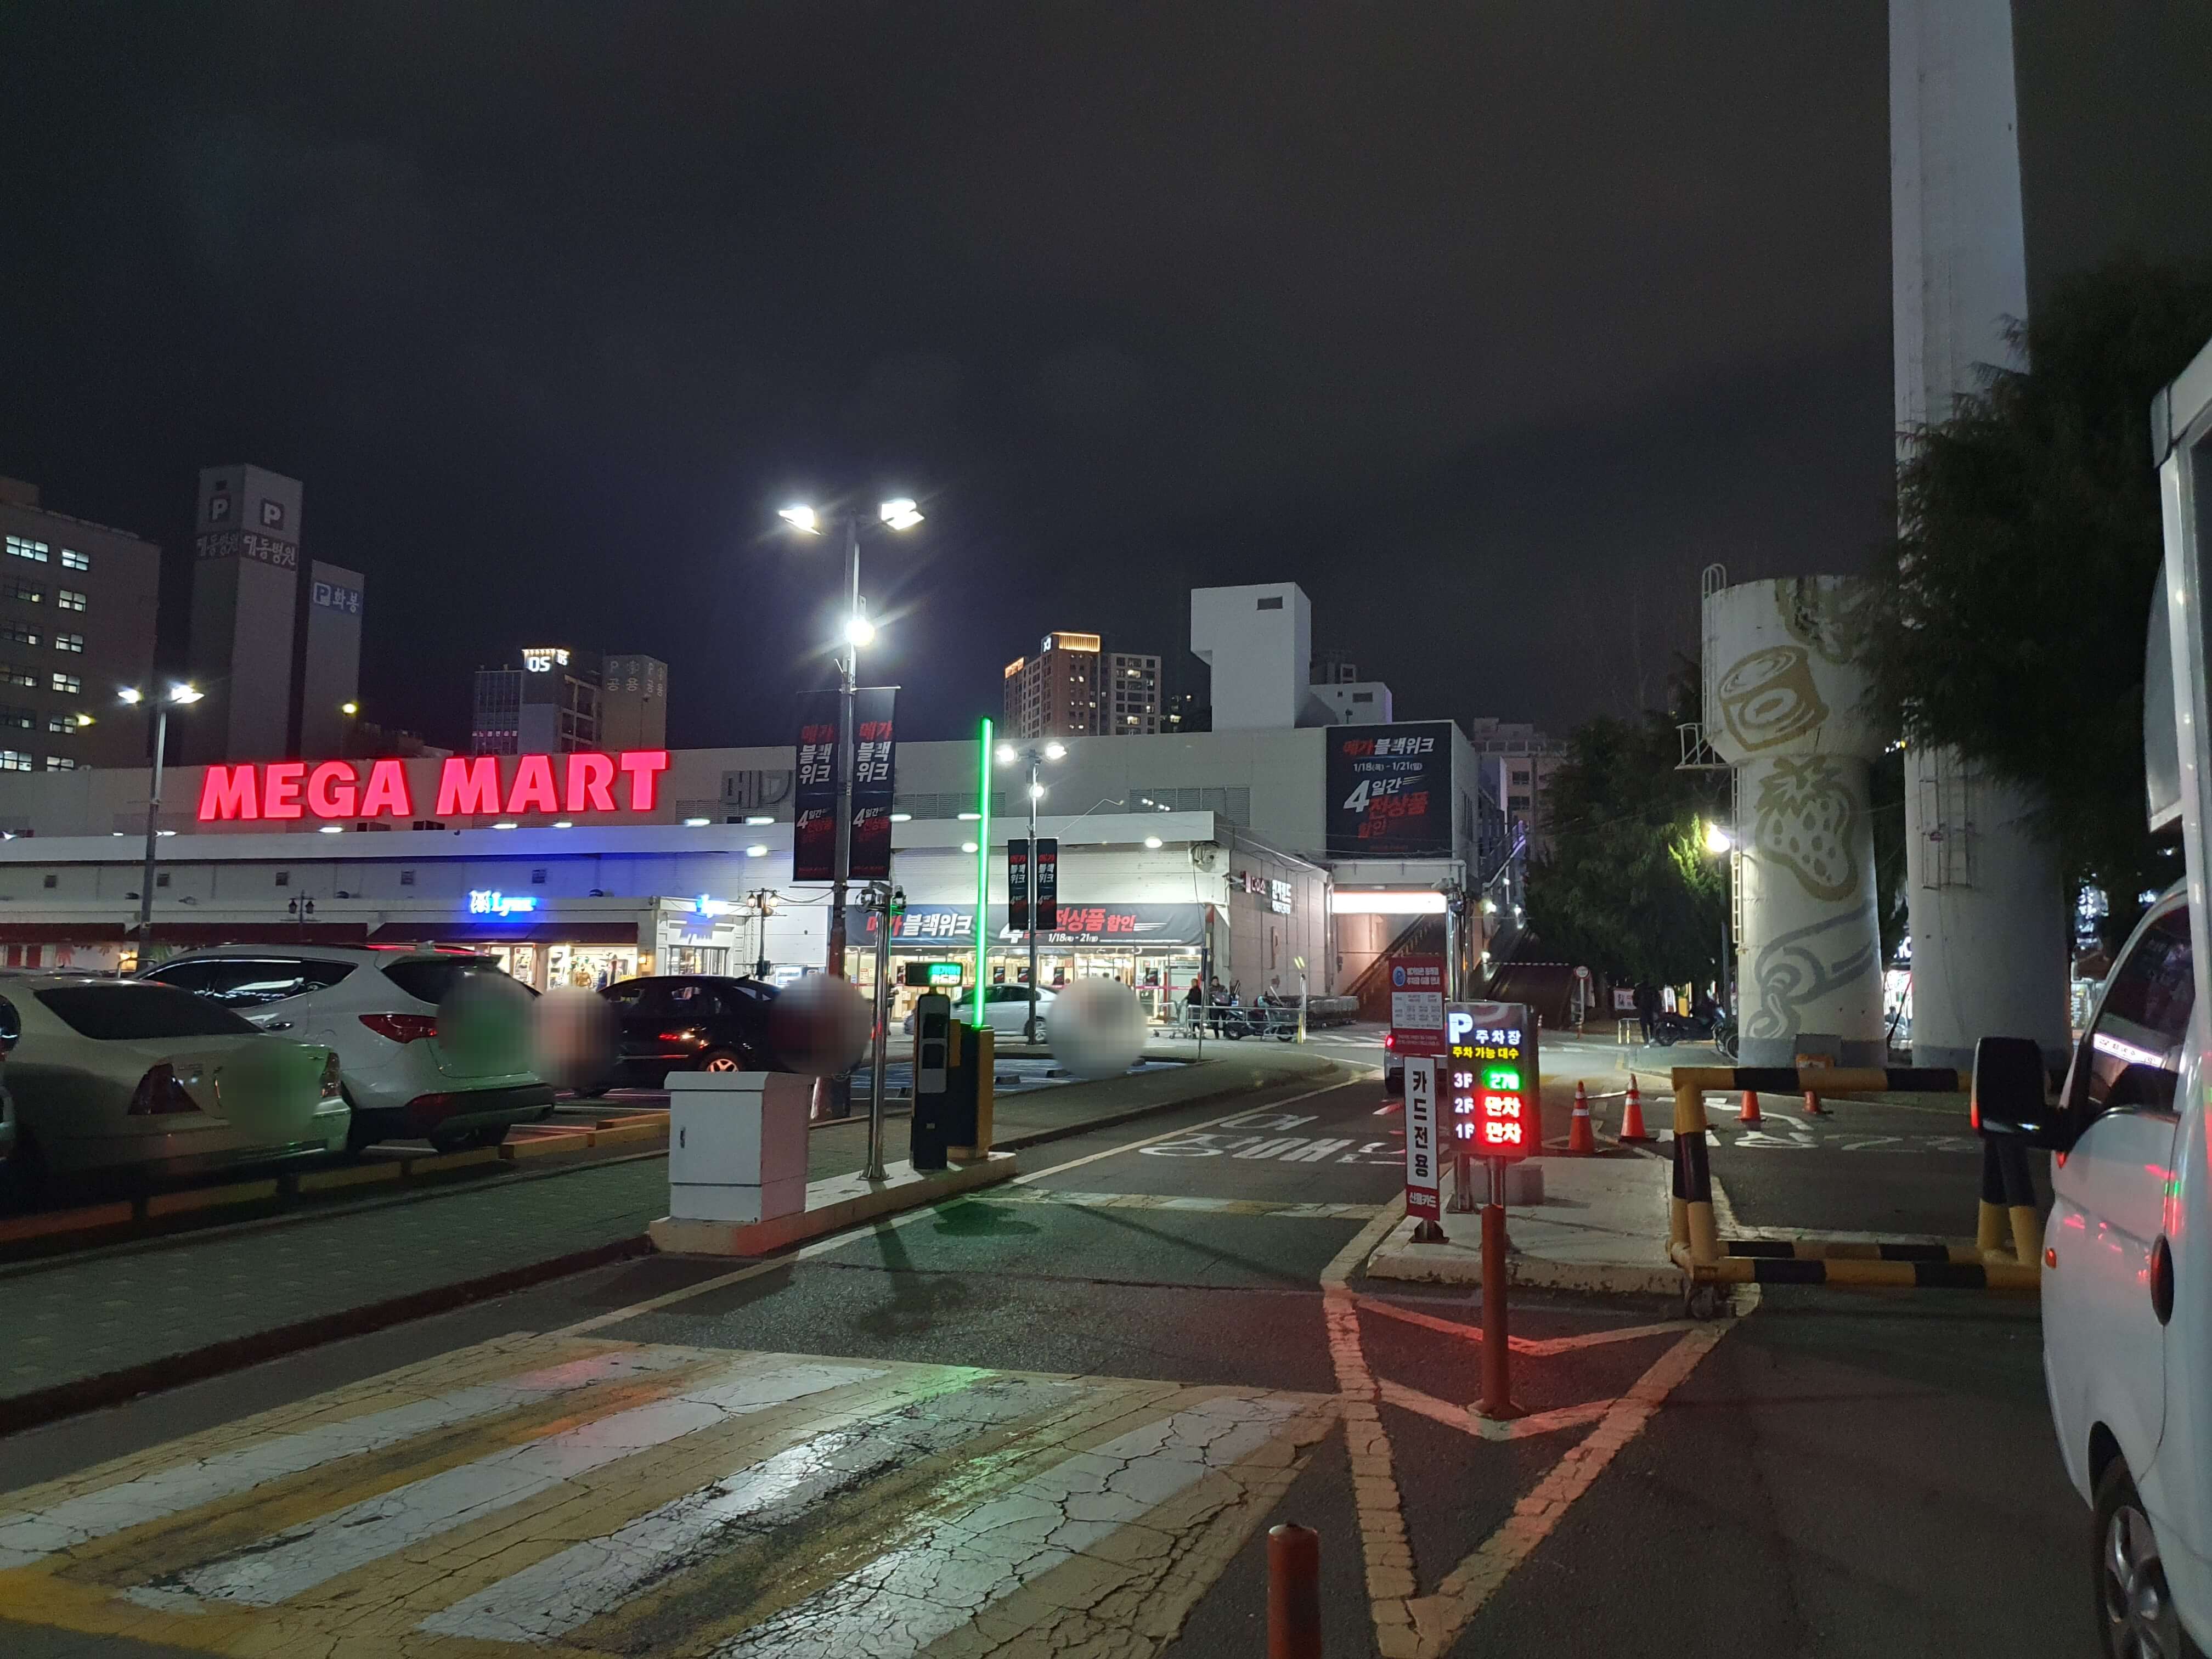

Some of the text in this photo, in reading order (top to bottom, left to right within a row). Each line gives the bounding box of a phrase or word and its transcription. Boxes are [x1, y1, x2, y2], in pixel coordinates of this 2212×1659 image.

[263, 503, 281, 524] P
[243, 534, 296, 566] 대동병원
[860, 720, 893, 741] 메가
[799, 743, 833, 765] 블랙
[857, 741, 891, 762] 블랙
[1374, 737, 1435, 755] 블랙위크
[799, 763, 831, 785] 위크
[856, 762, 889, 782] 위크
[198, 750, 668, 821] MEGA MART
[1369, 792, 1429, 819] 전상품
[903, 913, 973, 936] 블랙위크
[1107, 915, 1136, 932] 할인
[1448, 1013, 1474, 1043] P
[1453, 1046, 1519, 1059] 주차 가능 대수
[1454, 1073, 1473, 1088] 3F
[1454, 1096, 1521, 1118] 2F 만차
[1413, 1070, 1429, 1178] 카드전용
[1455, 1122, 1522, 1144] 1F 만차
[1409, 1191, 1437, 1208] 신용카드
